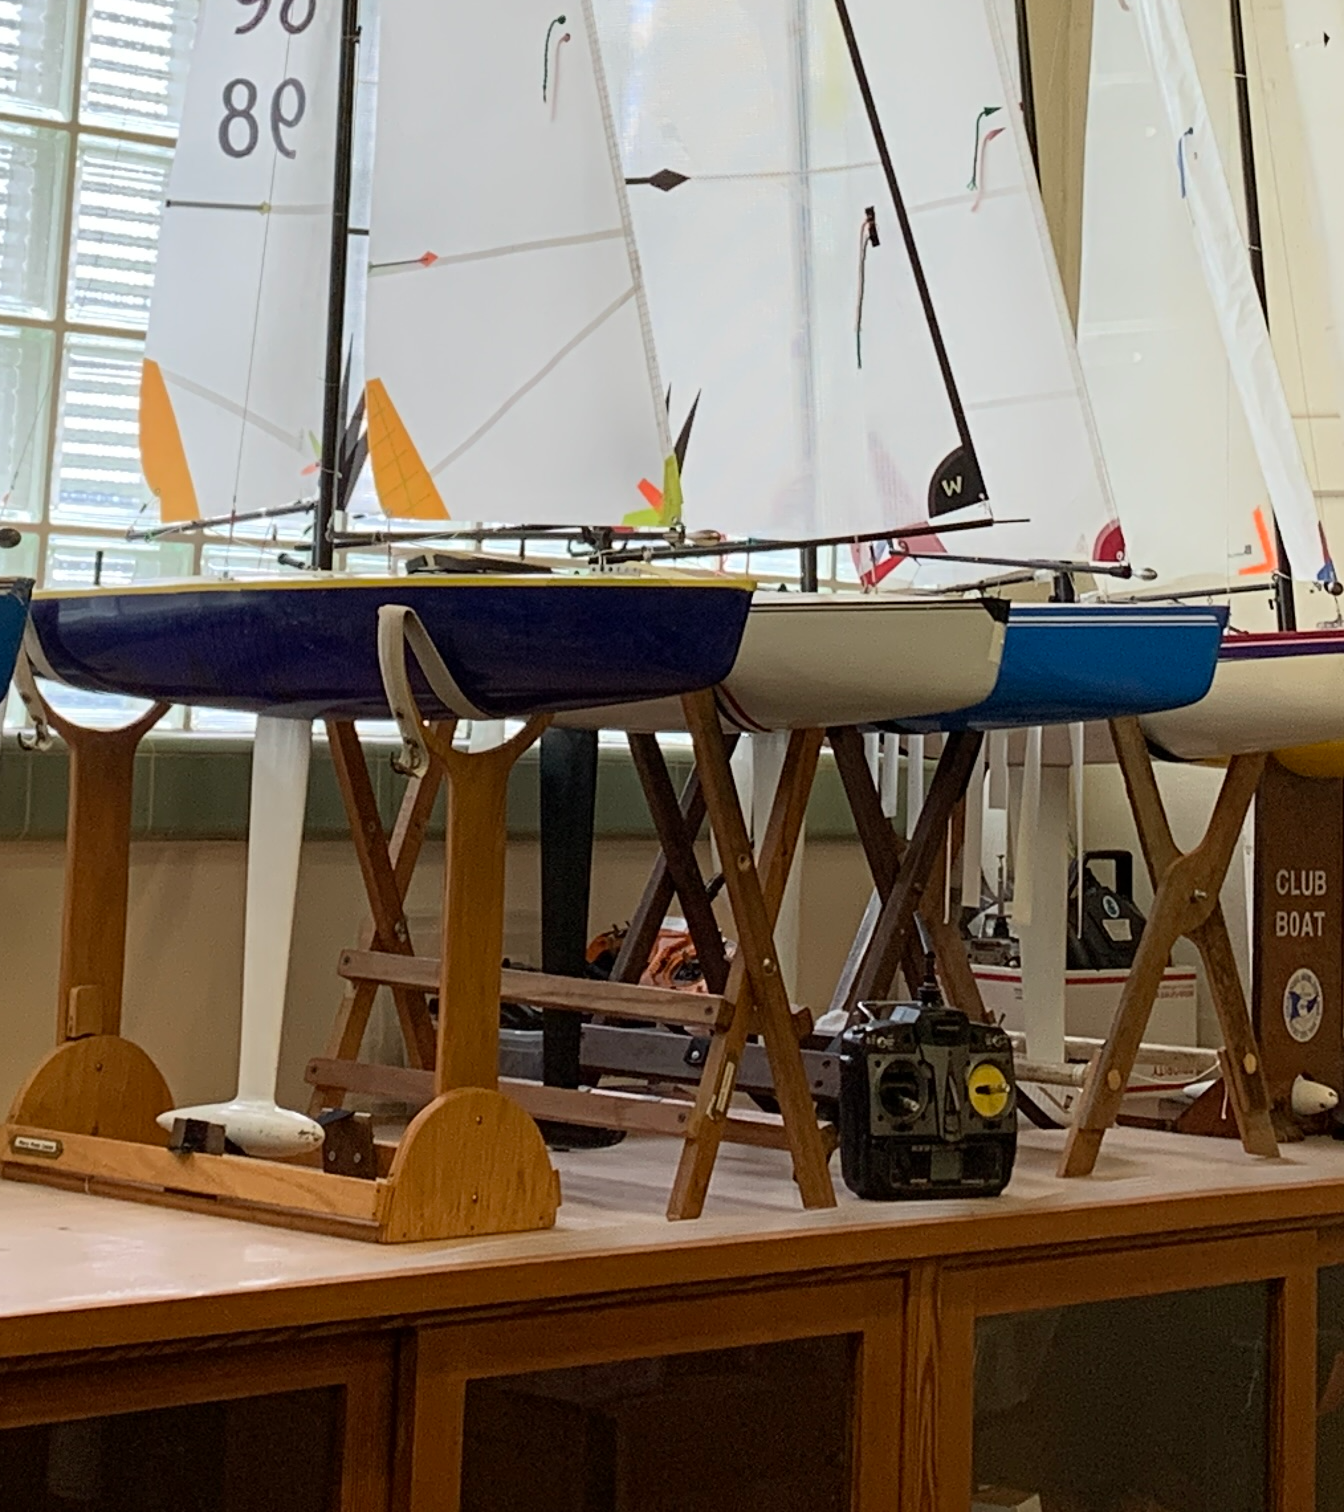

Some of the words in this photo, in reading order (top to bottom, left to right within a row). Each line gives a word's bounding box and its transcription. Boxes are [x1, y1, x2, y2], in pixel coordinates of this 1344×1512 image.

[941, 475, 963, 497] W
[1275, 869, 1328, 896] CLUB
[1275, 911, 1327, 938] BOAT
